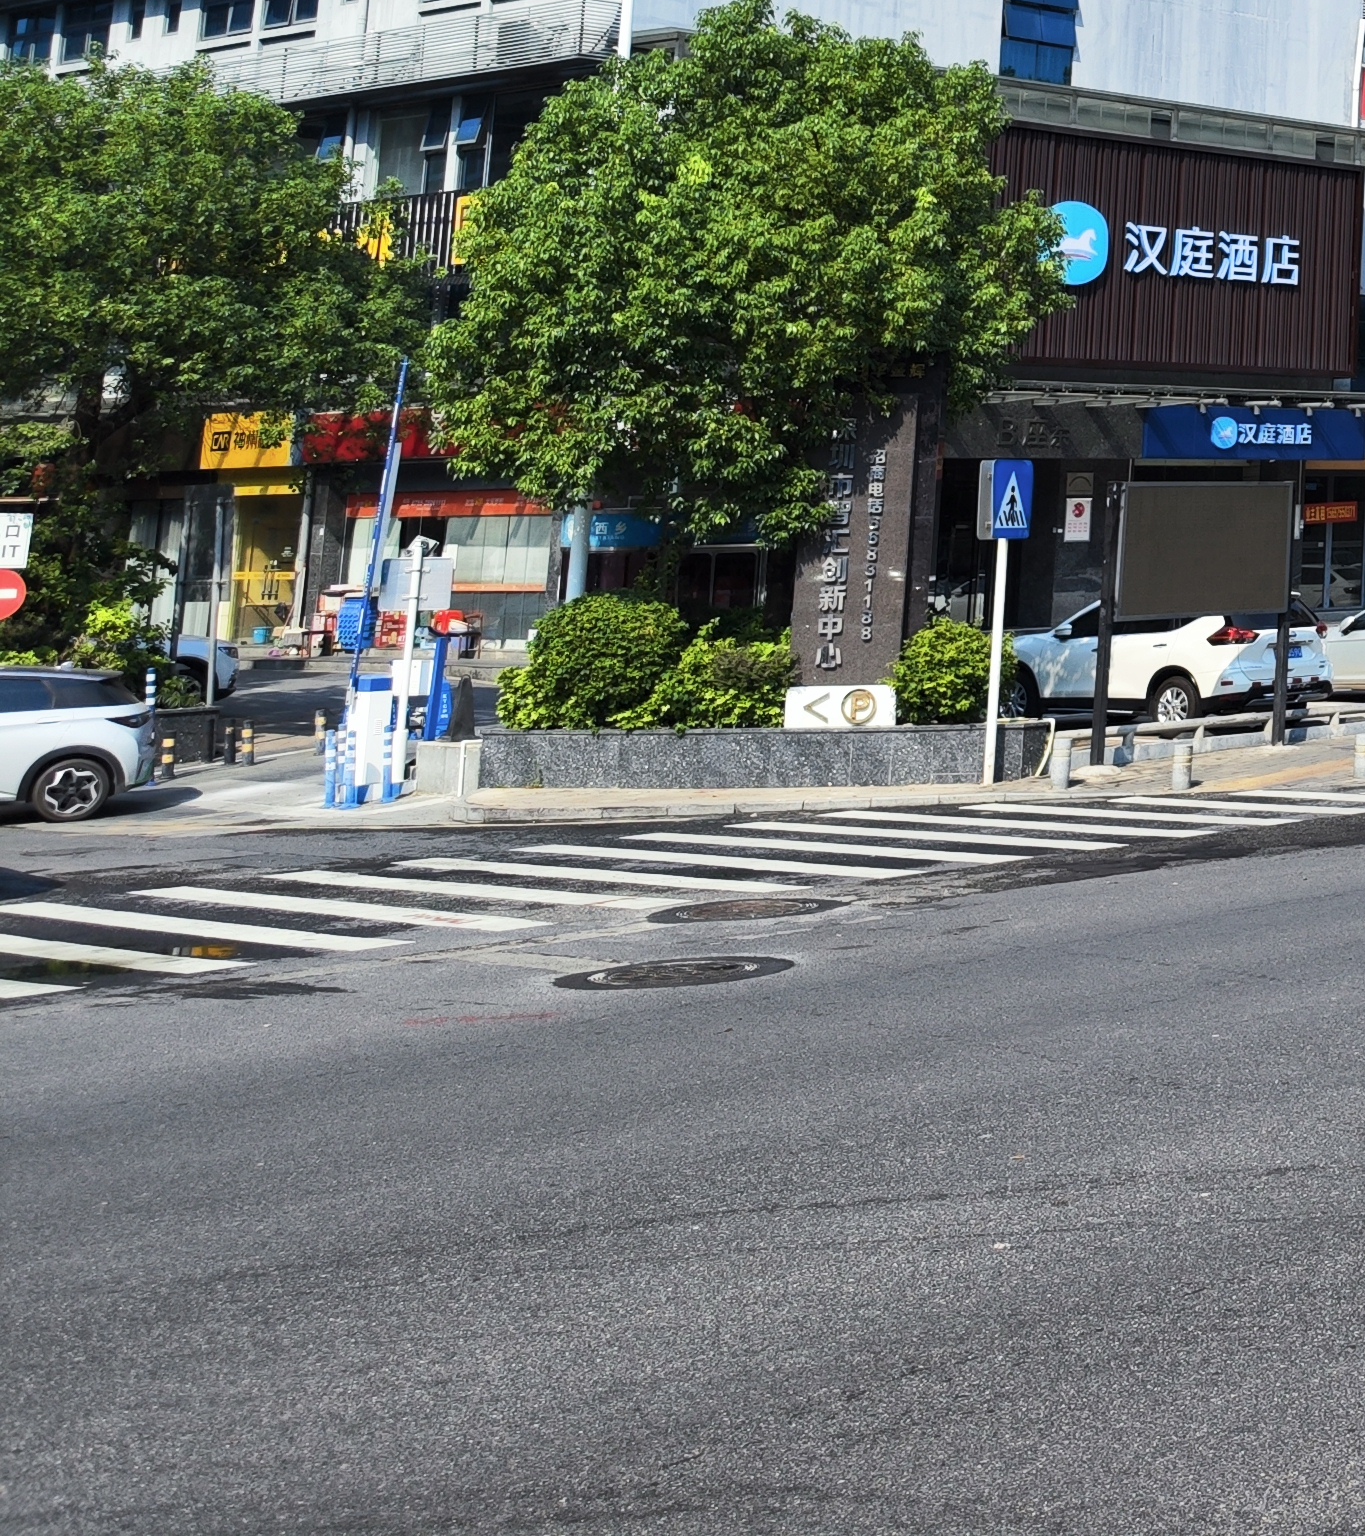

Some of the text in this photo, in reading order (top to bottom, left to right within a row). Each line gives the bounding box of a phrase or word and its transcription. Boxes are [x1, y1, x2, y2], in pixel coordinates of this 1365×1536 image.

[1124, 221, 1300, 286] 汉庭酒店
[234, 431, 286, 451] 神州
[1238, 422, 1313, 446] 汉庭酒店
